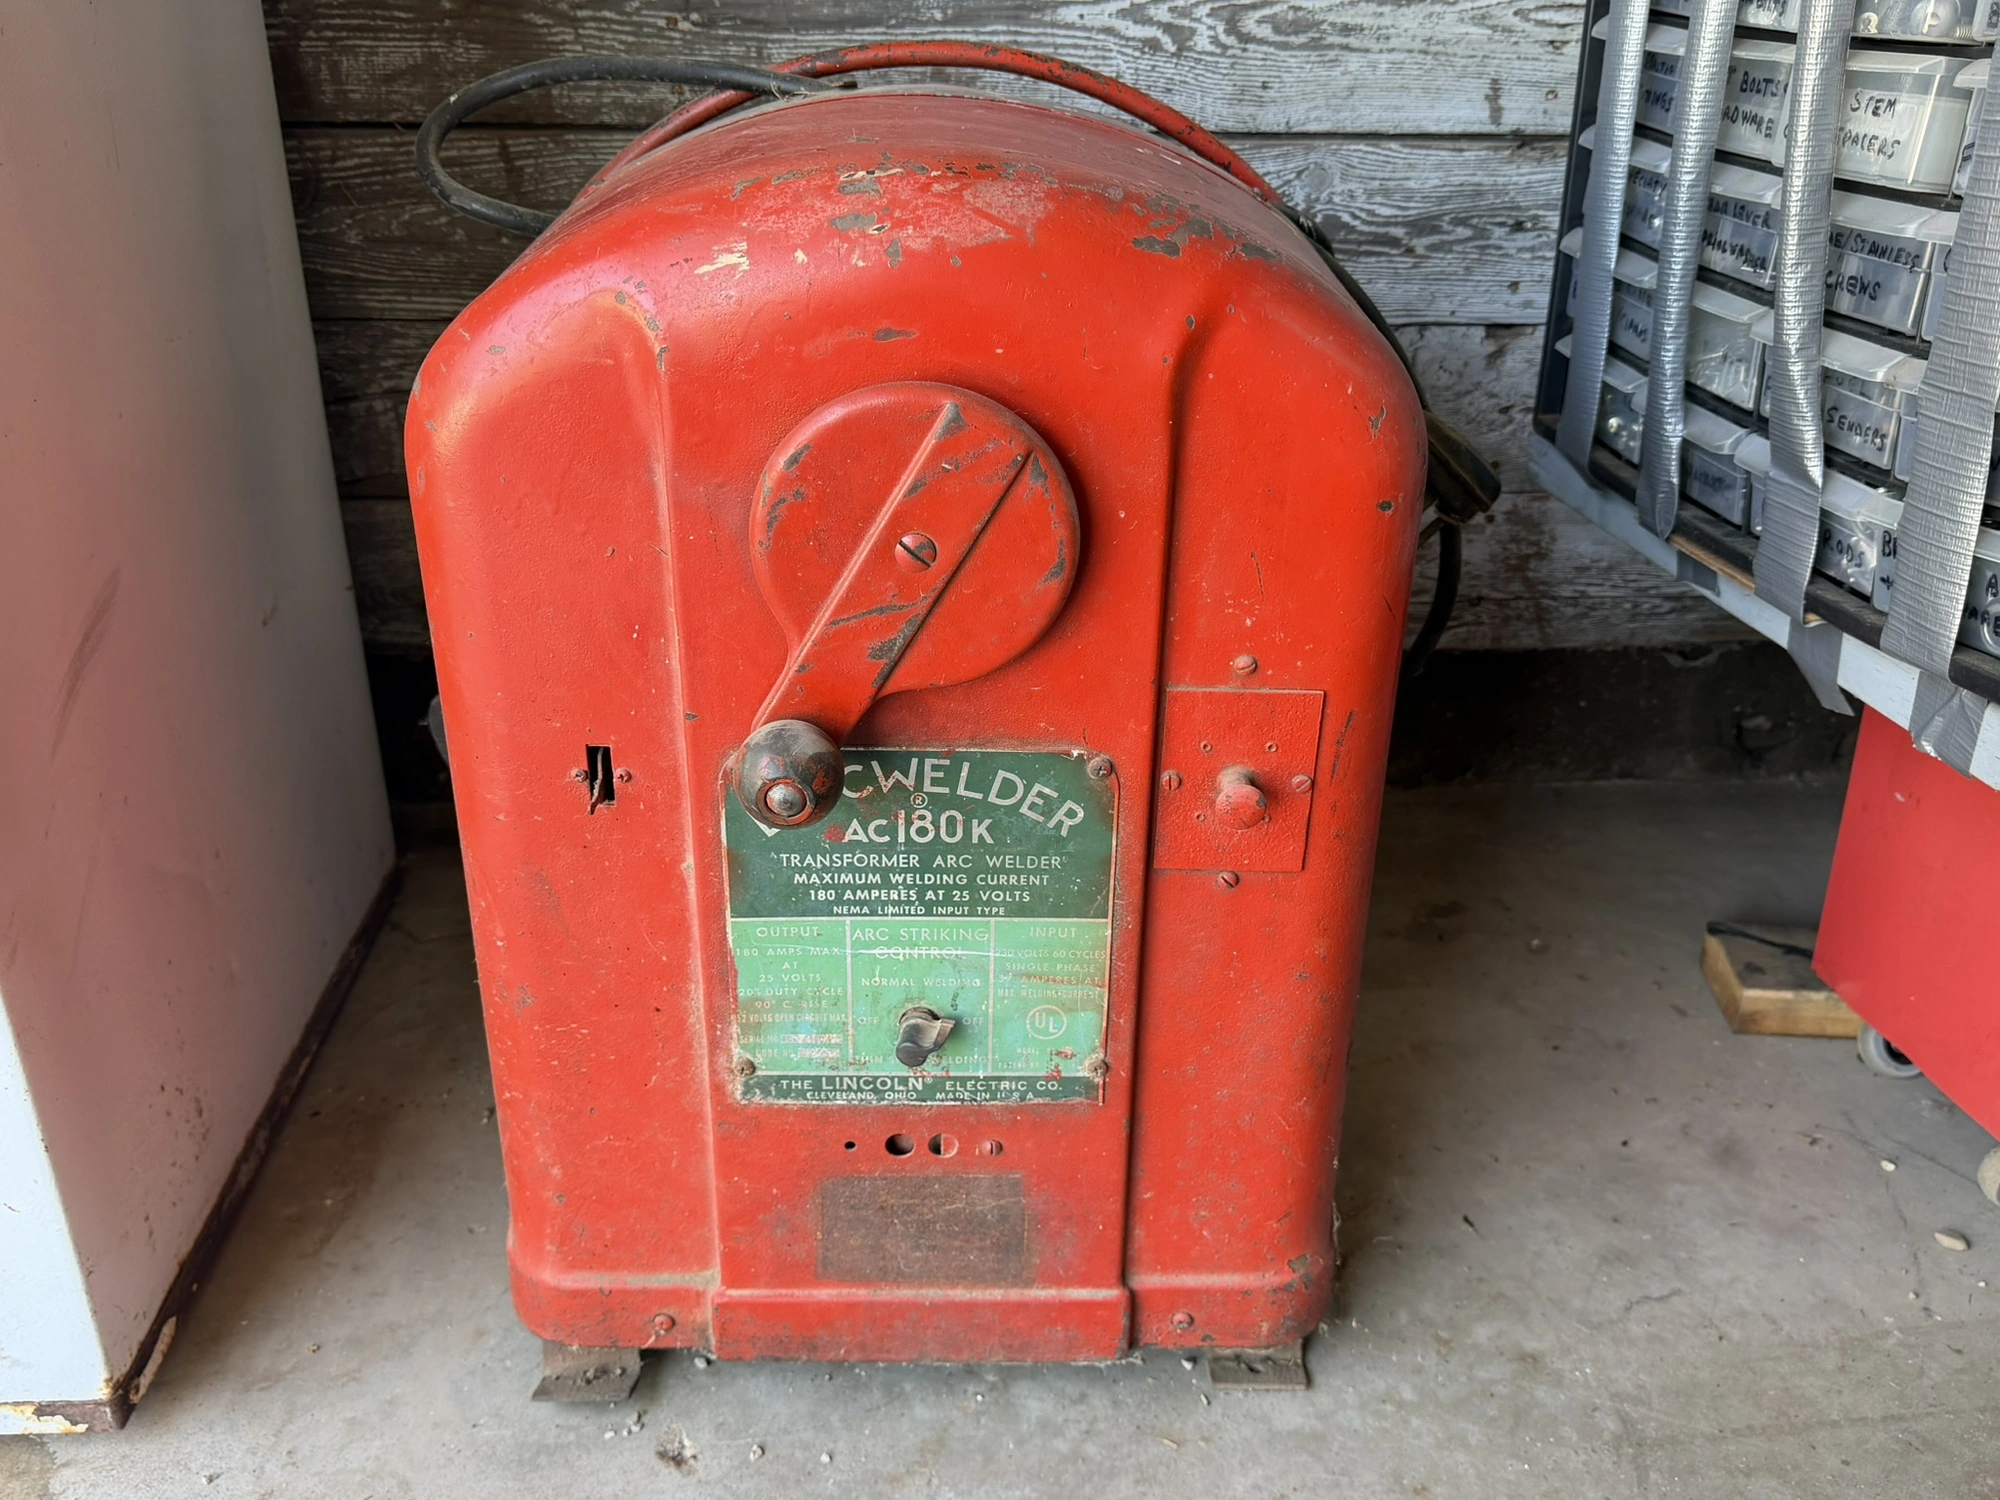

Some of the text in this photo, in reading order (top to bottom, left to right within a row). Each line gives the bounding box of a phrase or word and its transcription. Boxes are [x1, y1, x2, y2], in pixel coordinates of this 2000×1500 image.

[1739, 70, 1781, 98] BOLTS
[1849, 89, 1898, 119] STEM
[1721, 104, 1775, 139] RDWARE
[1836, 126, 1902, 160] SPACERS
[1824, 269, 1881, 302] CREWS
[1825, 405, 1888, 452] SENDERS
[1822, 528, 1865, 568] RODS
[745, 756, 1085, 839] CWELDER
[780, 853, 1062, 869] TRANSFORMER ARC WELDER
[793, 873, 1050, 886] MAXIMUM WELDING CURRENT
[809, 889, 1031, 902] 180 AMPERES AT 25 VOLTS
[833, 905, 1006, 916] NEMA LIMITED INPUT TYPE
[755, 926, 820, 938] OUTPUT
[852, 928, 989, 941] ARC STRIKING
[1030, 927, 1077, 939] INPUT
[736, 947, 759, 957] 180
[766, 947, 803, 956] AMPS
[875, 946, 967, 960] CONTROL
[1017, 949, 1050, 959] VOLTS
[1052, 949, 1066, 958] 60
[1068, 949, 1107, 960] CYCLES
[781, 961, 799, 970] AT
[1005, 962, 1096, 973] SINGLE PHASE
[758, 973, 822, 983] 25 VOLTS
[861, 977, 981, 988] NORMAL WELDING
[1021, 975, 1077, 985] AMPERES
[1084, 976, 1101, 985] AT
[765, 987, 798, 996] DUTY
[806, 986, 844, 996] CYCLE
[1021, 989, 1058, 998] WELDING
[800, 1000, 829, 1009] RISE
[749, 1013, 773, 1023] VOLTS
[774, 1013, 795, 1022] OPEN
[857, 1016, 880, 1025] OFF
[962, 1017, 985, 1026] OFF
[780, 1079, 813, 1090] THE
[945, 1079, 1028, 1091] ELECTRIC
[1036, 1080, 1063, 1091] CO.
[884, 1090, 917, 1100] OHIO
[935, 1091, 971, 1101] MADE
[976, 1091, 990, 1101] IN
